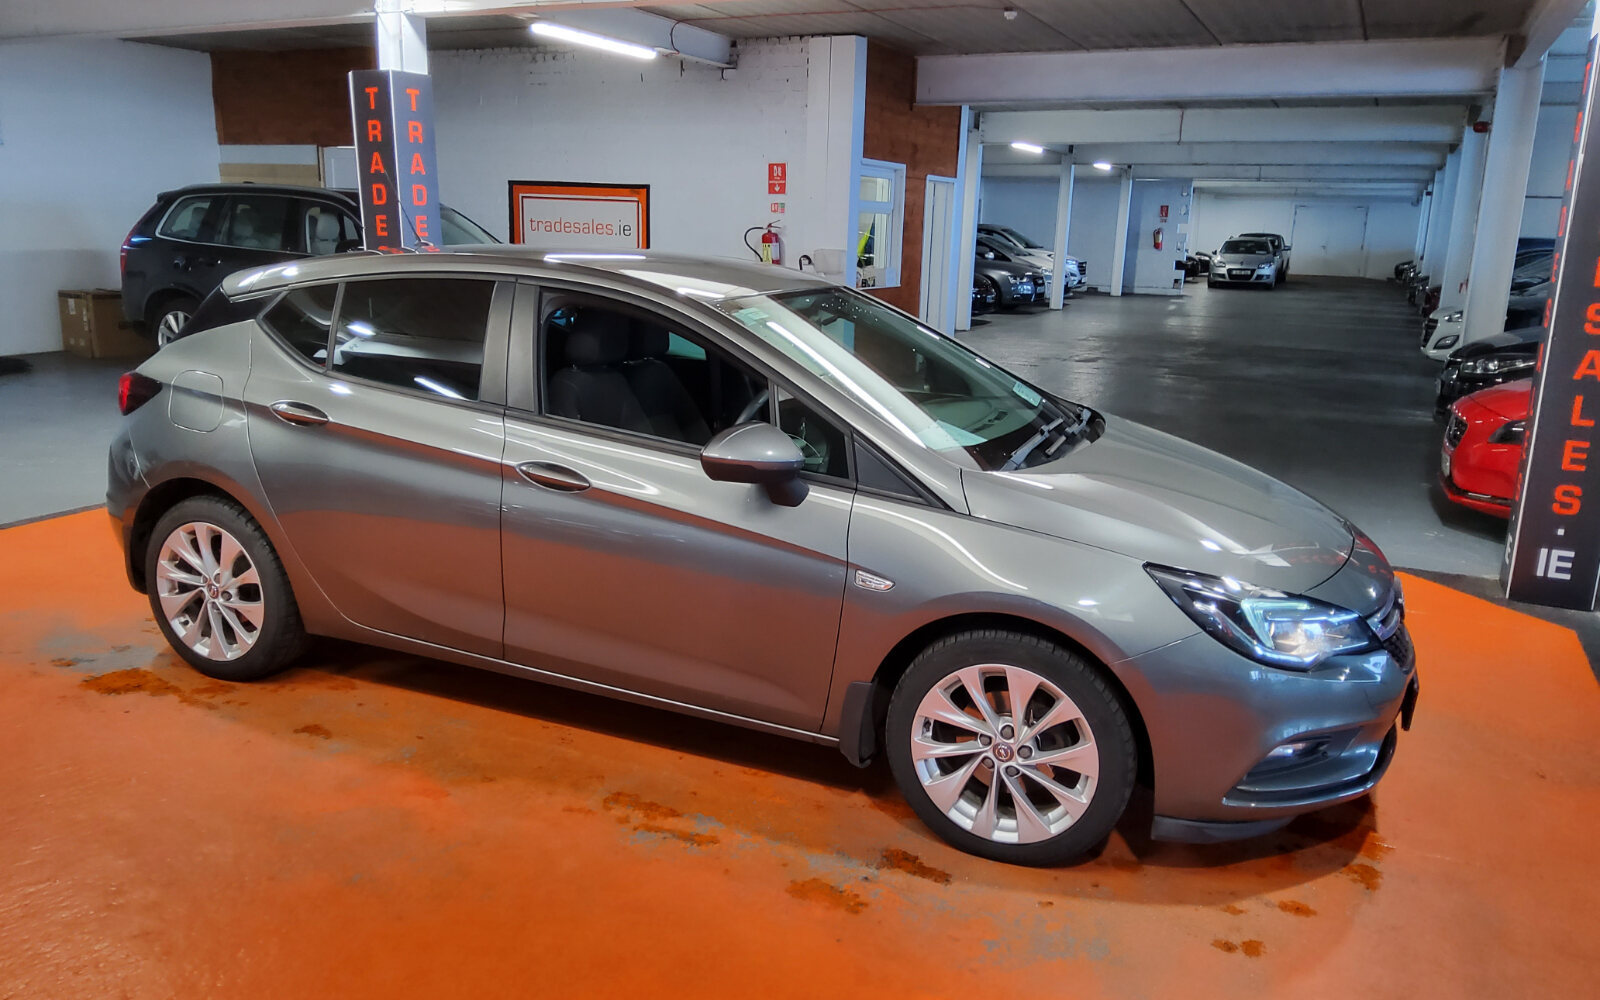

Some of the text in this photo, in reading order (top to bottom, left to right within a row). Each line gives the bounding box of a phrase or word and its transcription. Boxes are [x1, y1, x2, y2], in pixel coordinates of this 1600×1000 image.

[365, 86, 391, 252] TRADE
[406, 88, 436, 251] TRADE
[529, 217, 632, 237] tradesales.ie
